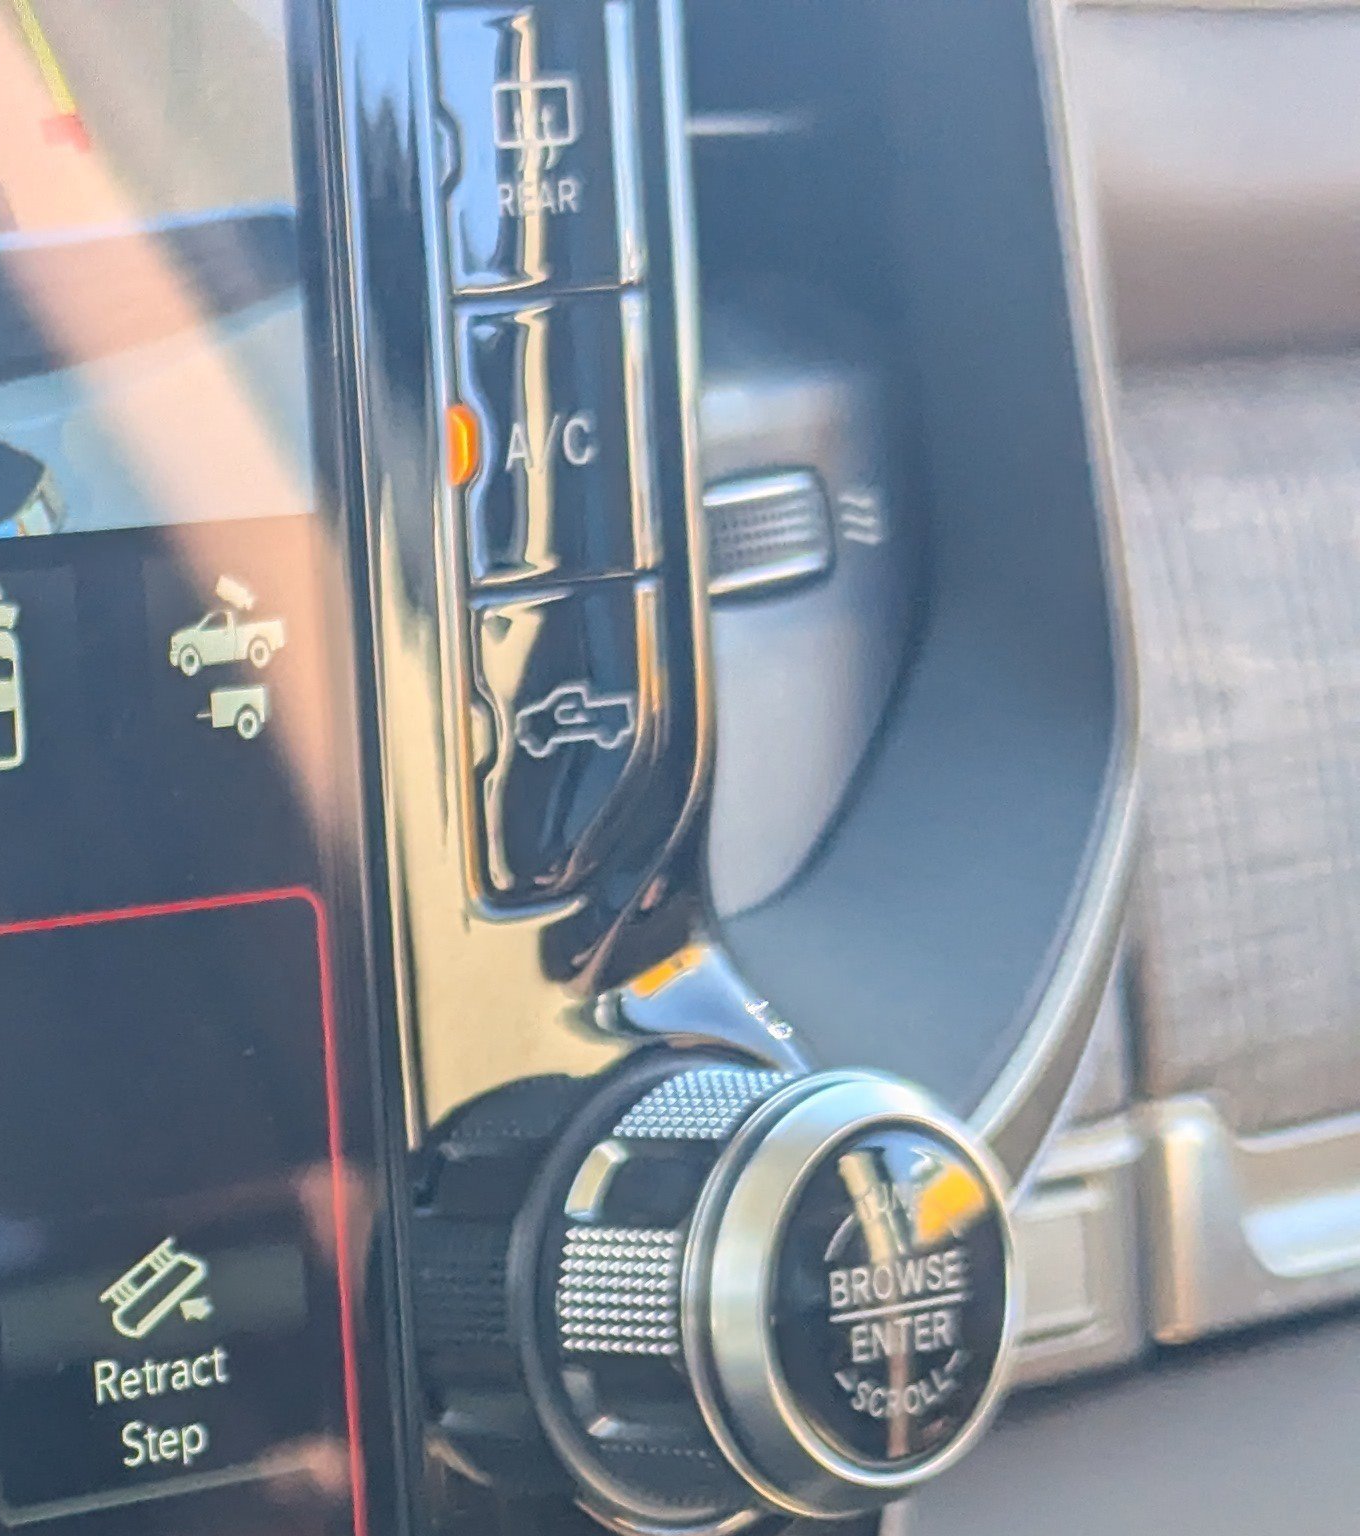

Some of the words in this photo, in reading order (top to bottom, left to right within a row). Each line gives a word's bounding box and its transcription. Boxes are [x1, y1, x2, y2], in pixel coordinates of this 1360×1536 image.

[498, 180, 579, 218] REAR
[829, 1249, 966, 1308] BROWSE
[851, 1310, 953, 1363] ENTER
[94, 1345, 228, 1404] Retract
[121, 1418, 208, 1471] Step
